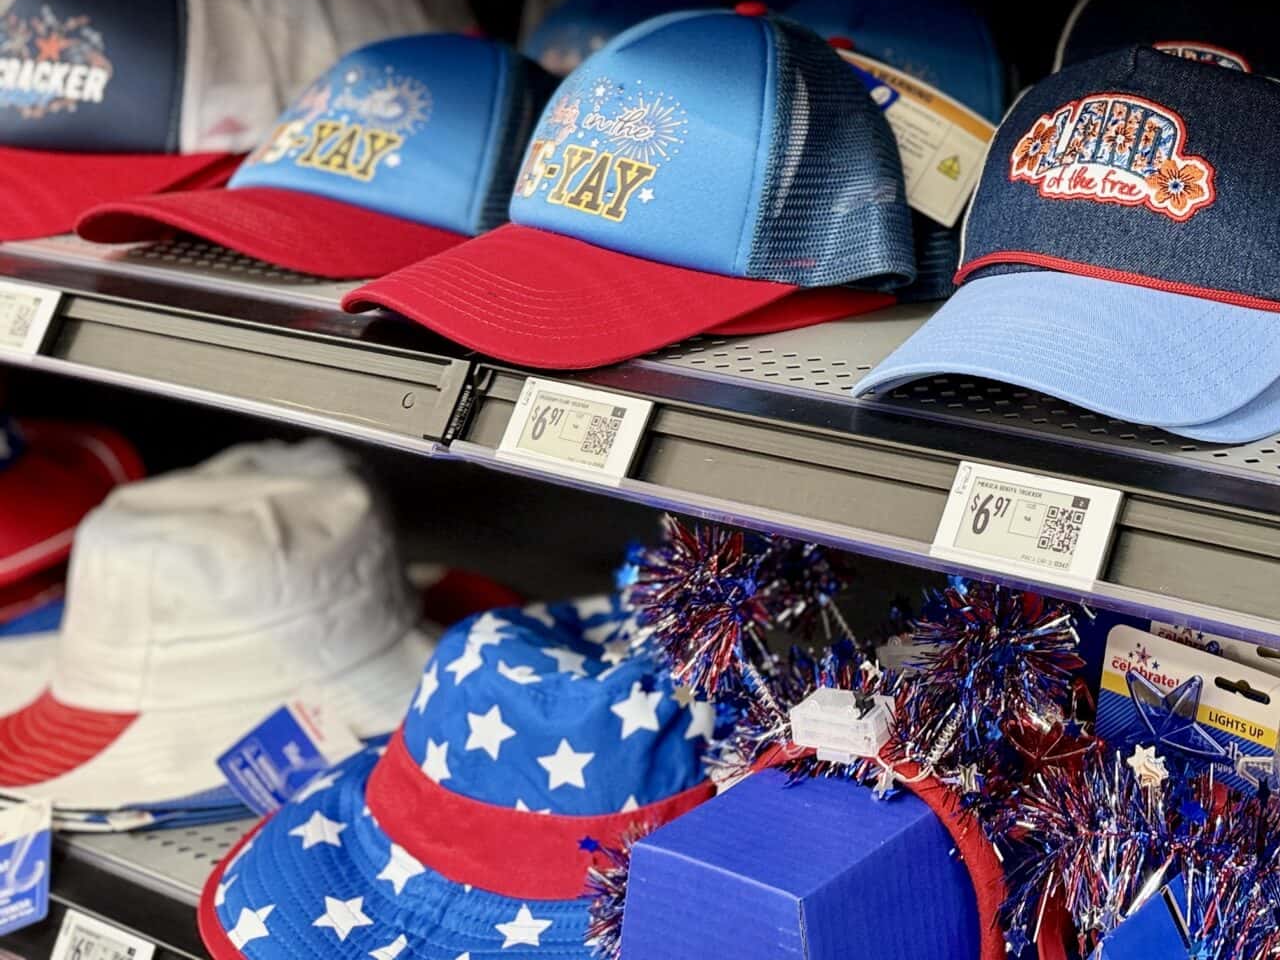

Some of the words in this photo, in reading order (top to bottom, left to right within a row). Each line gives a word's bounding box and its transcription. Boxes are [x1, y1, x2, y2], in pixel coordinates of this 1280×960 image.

[1068, 167, 1097, 191] the
[1101, 170, 1142, 197] free
[1208, 711, 1247, 734] LIGHTS
[1248, 725, 1265, 739] UP
